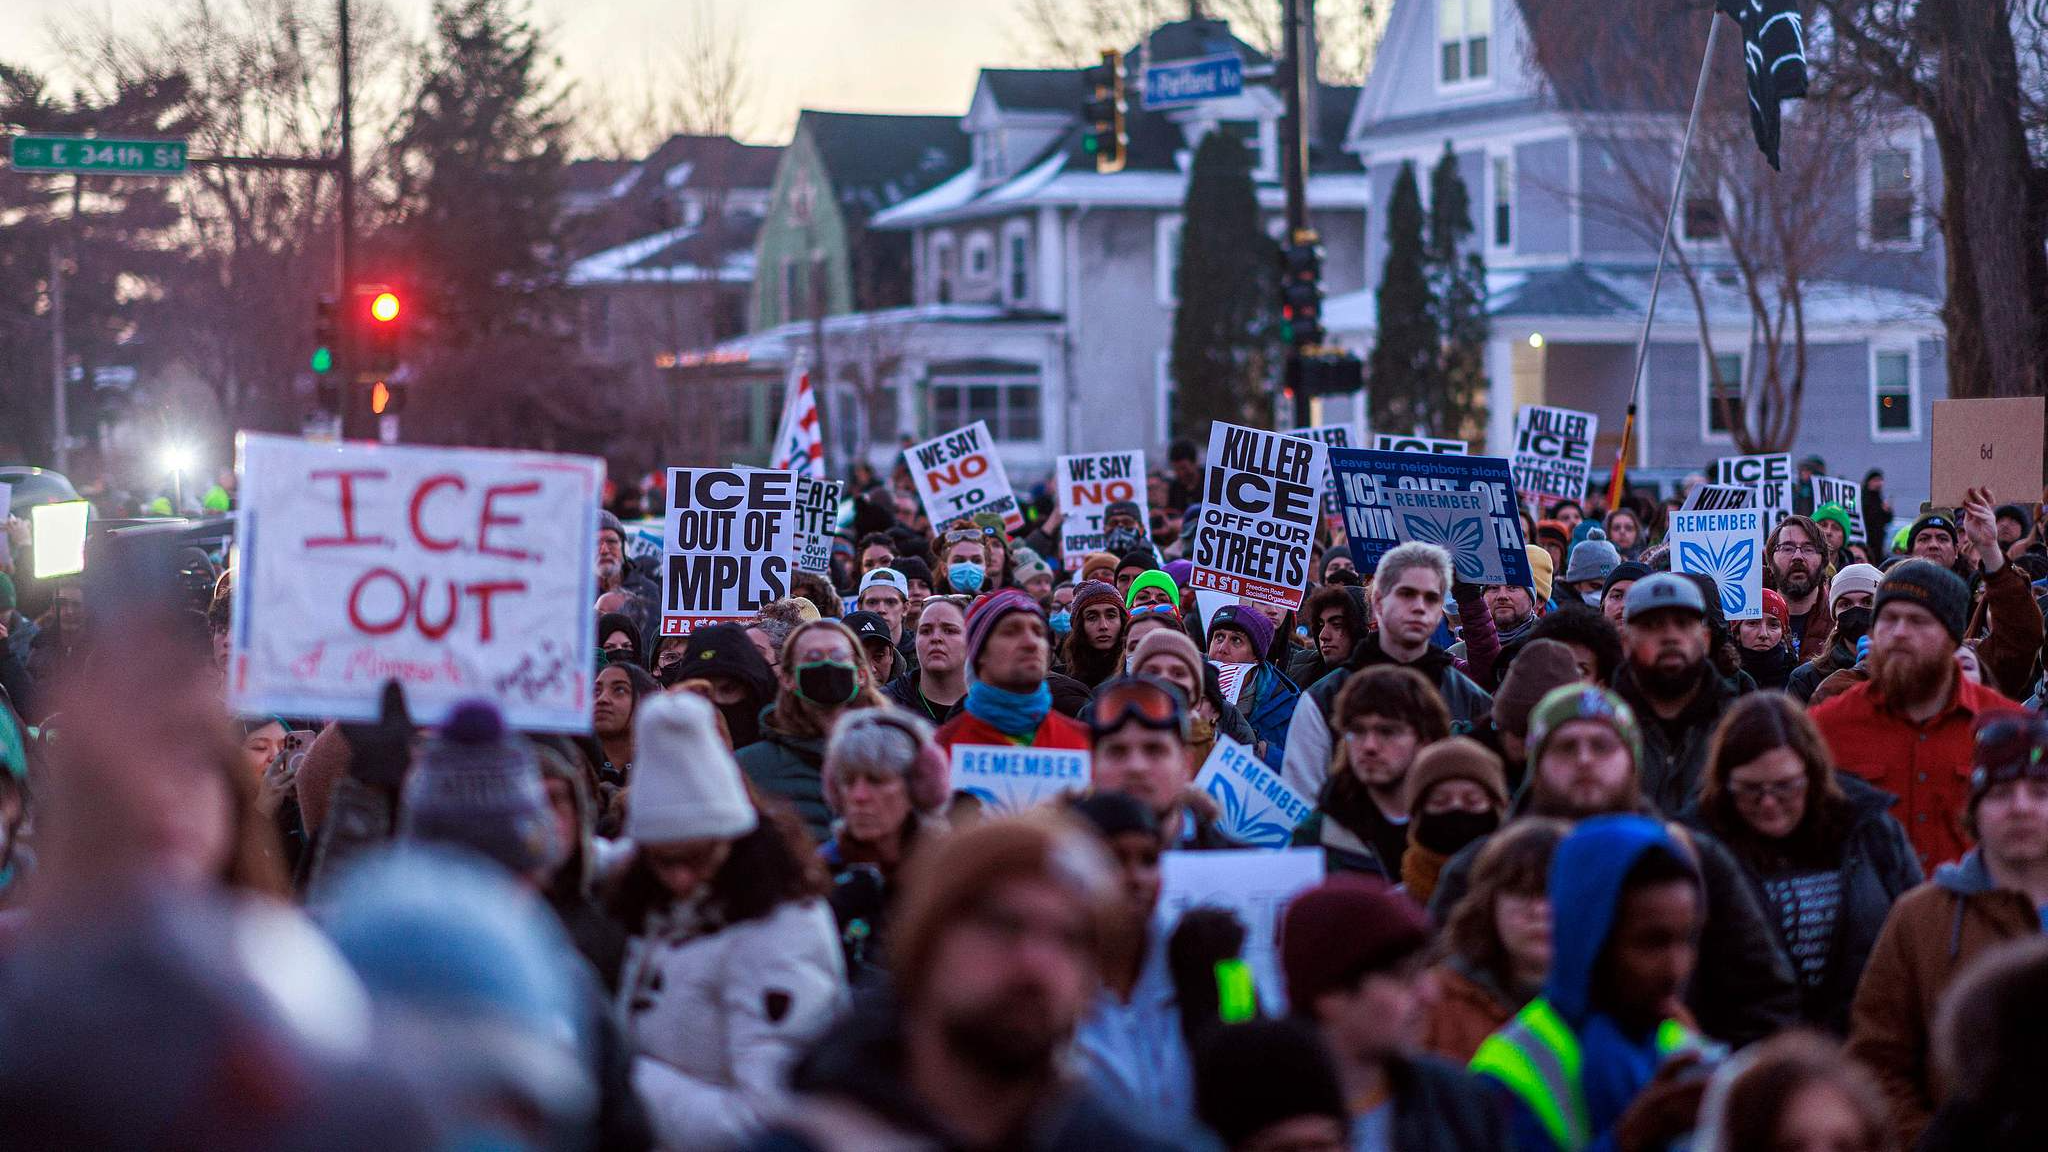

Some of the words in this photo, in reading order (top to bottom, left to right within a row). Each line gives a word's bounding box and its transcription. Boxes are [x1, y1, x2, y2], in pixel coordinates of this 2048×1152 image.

[52, 143, 67, 164] E
[80, 144, 144, 167] 34th
[153, 147, 181, 168] St
[1528, 408, 1588, 441] KILLER
[916, 443, 948, 471] WE
[945, 428, 980, 460] SAY
[1220, 426, 1313, 485] KILLER
[1518, 431, 1589, 463] ICE
[1981, 443, 1993, 460] 6d
[926, 454, 988, 494] NO
[1068, 458, 1096, 481] WE
[1099, 455, 1132, 479] SAY
[1333, 458, 1371, 468] Leave
[1374, 462, 1396, 470] our
[1400, 462, 1469, 476] neighbors
[1471, 466, 1509, 478] alone
[1512, 466, 1584, 500] STREETS
[1723, 456, 1789, 484] ICE
[674, 470, 792, 511] ICE
[949, 488, 985, 511] TO
[1071, 482, 1134, 507] NO
[1208, 465, 1315, 526] ICE
[1341, 472, 1390, 507] ICE
[1394, 492, 1482, 510] REMEMBER
[1763, 483, 1784, 508] OF
[678, 509, 737, 551] OUT
[743, 510, 782, 552] OF
[1205, 509, 1254, 531] OFF
[1256, 520, 1310, 546] OUR
[1676, 513, 1757, 533] REMEMBER
[805, 544, 828, 557] OUR
[807, 534, 820, 545] IN
[800, 554, 829, 570] STATE
[1197, 526, 1306, 587] STREETS
[667, 554, 787, 612] MPLS
[347, 567, 527, 644] OUT
[962, 751, 1083, 779] REMEMBER
[1220, 745, 1311, 822] REMEMBER
